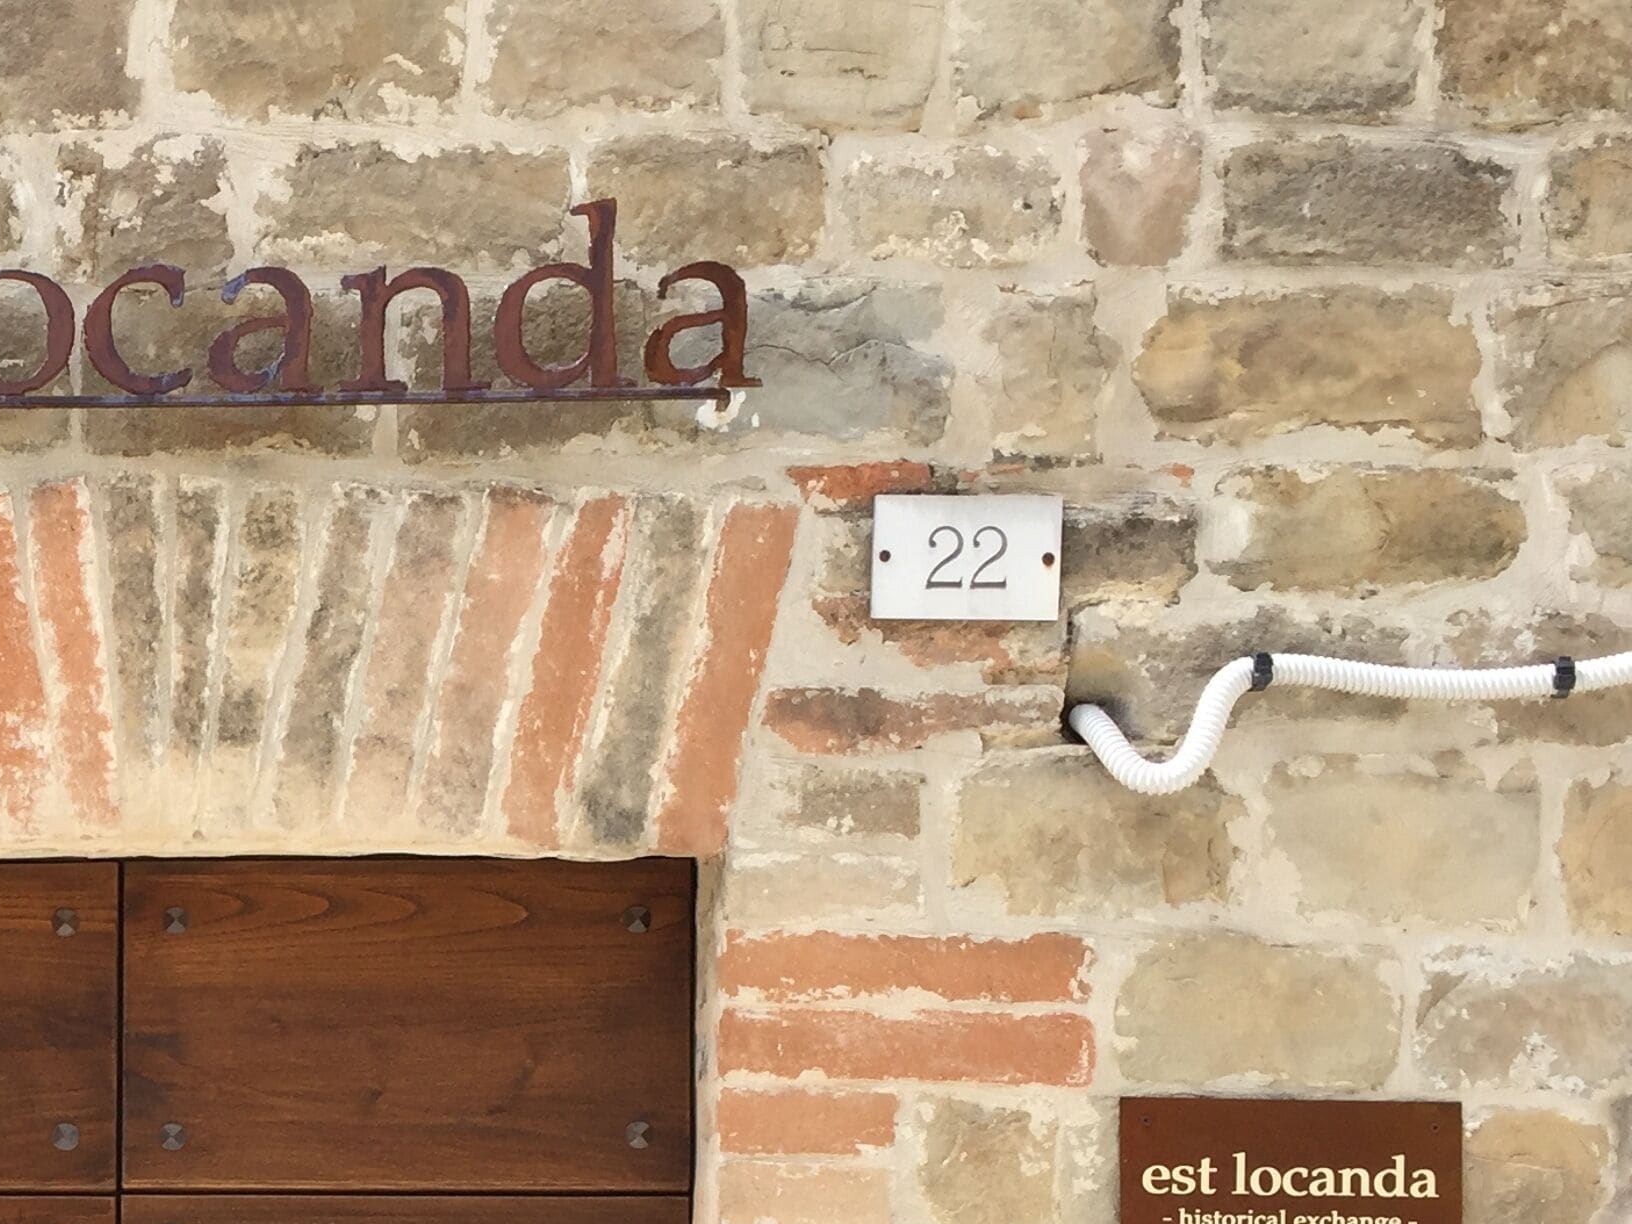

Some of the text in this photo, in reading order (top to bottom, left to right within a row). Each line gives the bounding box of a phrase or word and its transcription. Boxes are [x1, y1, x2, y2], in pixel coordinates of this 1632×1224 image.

[925, 525, 1008, 590] 22
[1141, 1152, 1439, 1198] est locanda
